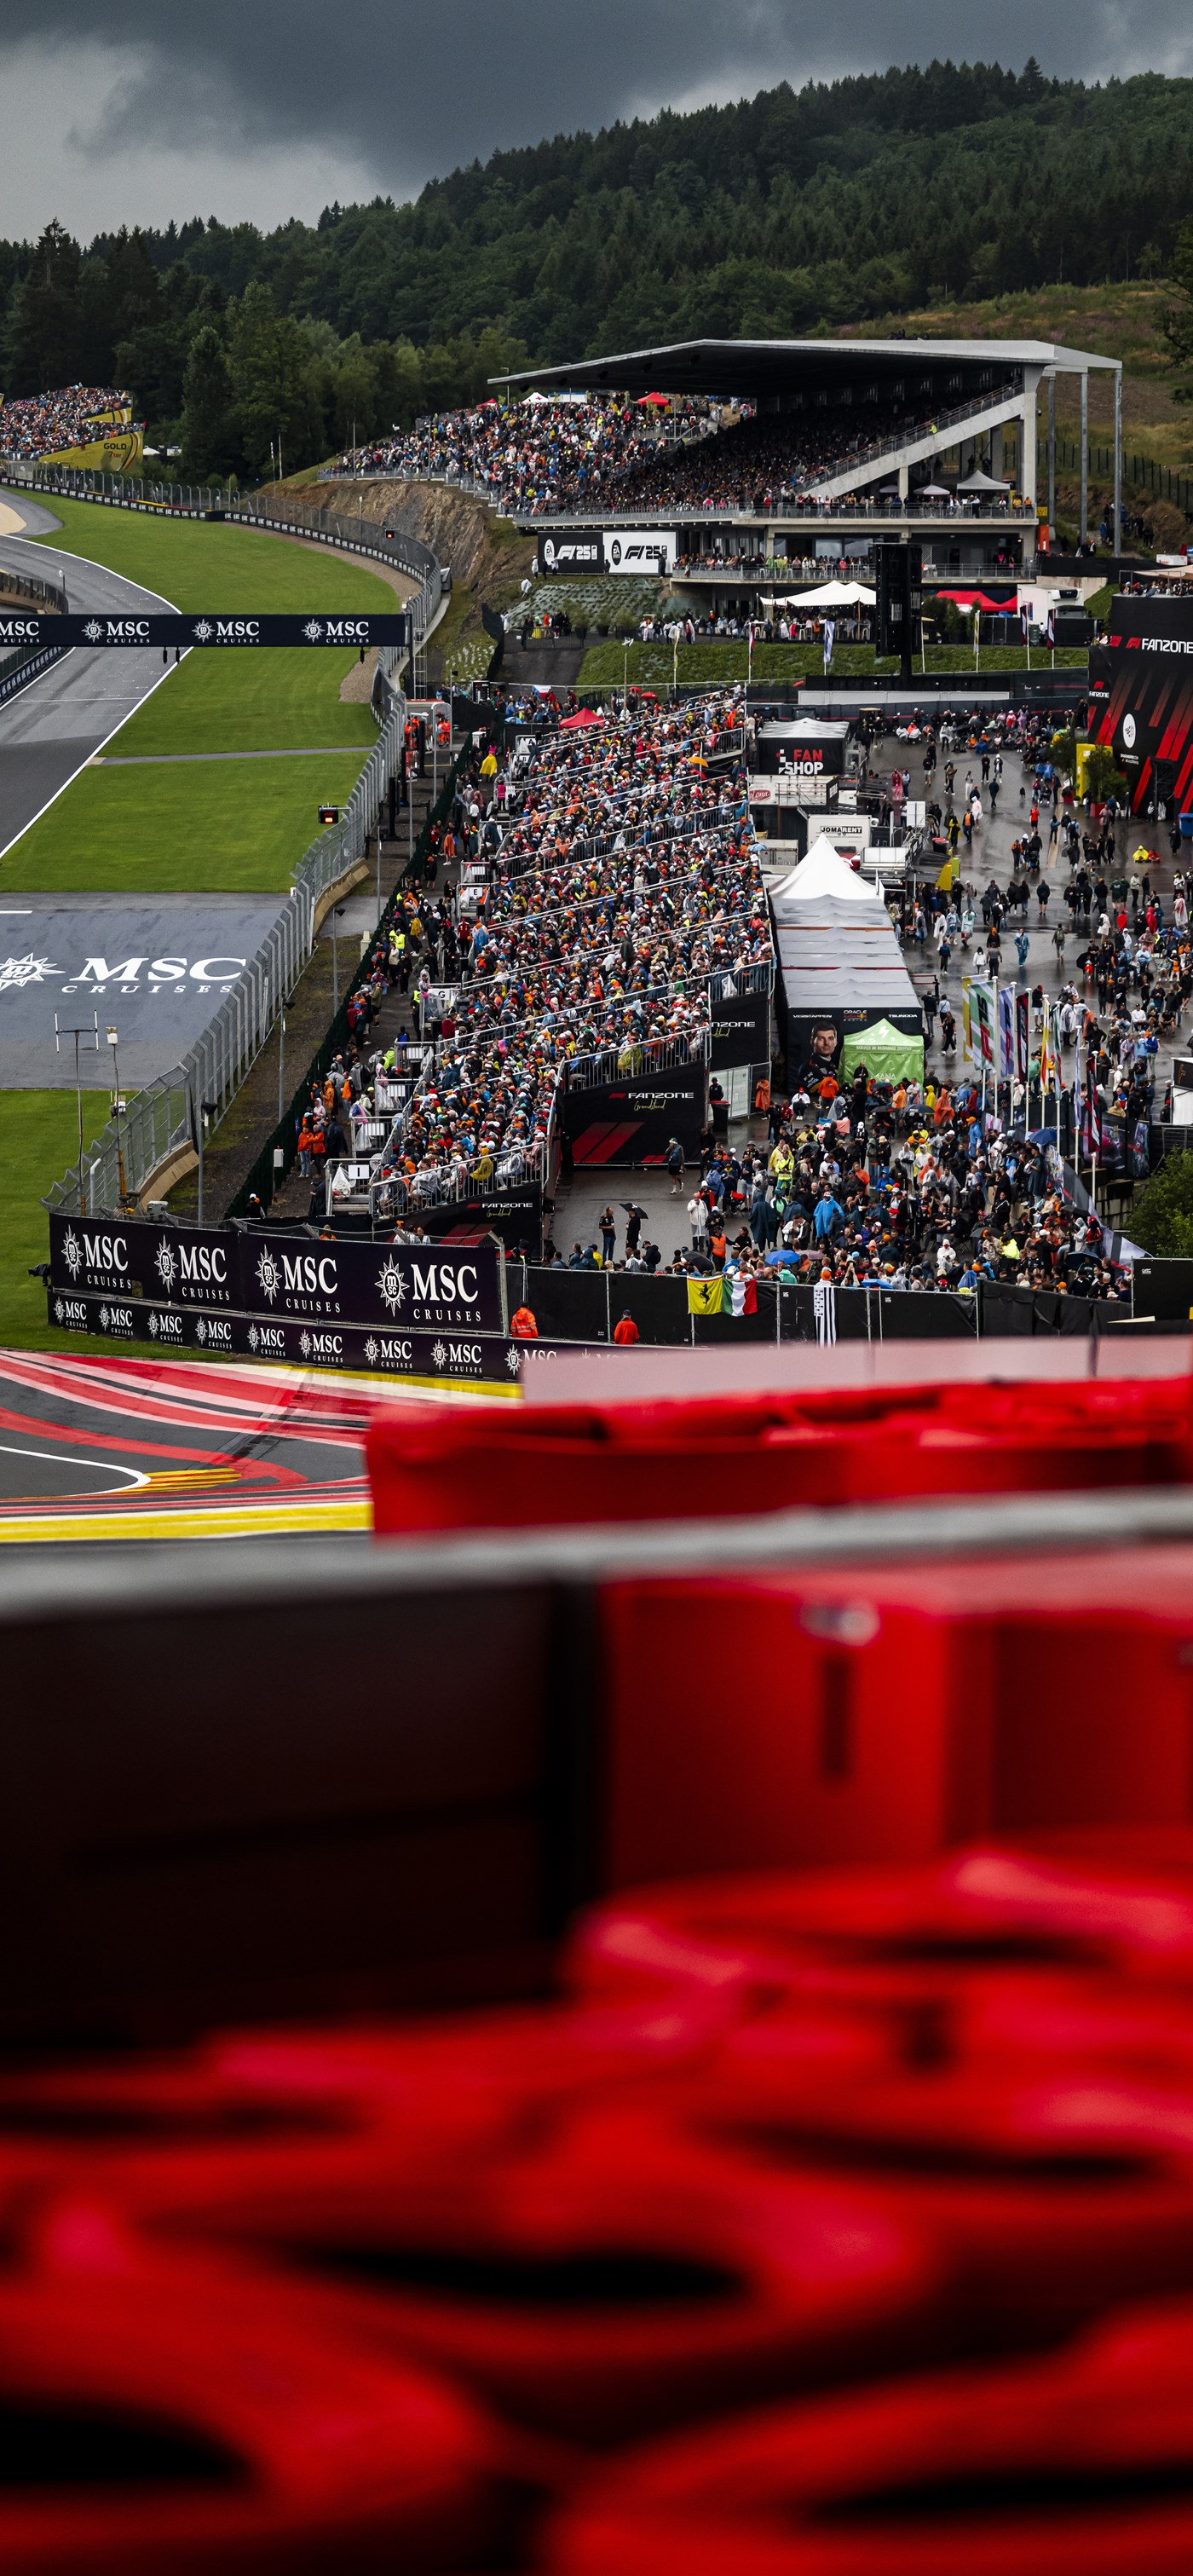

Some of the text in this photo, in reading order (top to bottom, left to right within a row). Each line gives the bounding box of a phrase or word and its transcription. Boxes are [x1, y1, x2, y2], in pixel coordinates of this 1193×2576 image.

[0, 621, 39, 636] MSC
[107, 621, 149, 636] MSC
[216, 621, 259, 636] MSC
[326, 621, 368, 636] MSC
[1142, 638, 1193, 653] FANZONE
[794, 750, 822, 761] FAN
[784, 762, 823, 775] SHOP
[69, 958, 246, 980] MSC
[83, 1234, 128, 1271] MSC
[178, 1245, 227, 1282] MSC
[88, 1274, 131, 1289] CRUISES
[281, 1255, 337, 1293] MSC
[411, 1264, 478, 1302] MSC
[182, 1287, 229, 1300] CRUISES
[66, 1302, 86, 1320] MSC
[286, 1298, 340, 1313] CRUISES
[111, 1308, 132, 1326] MSC
[159, 1315, 182, 1333] MSC
[414, 1309, 481, 1321] CRUISES
[112, 1328, 133, 1337] CRUISES
[208, 1321, 231, 1340] MSC
[260, 1328, 285, 1347] MSC
[313, 1334, 342, 1354] MSC
[381, 1340, 412, 1359] MSC
[449, 1344, 481, 1363] MSC
